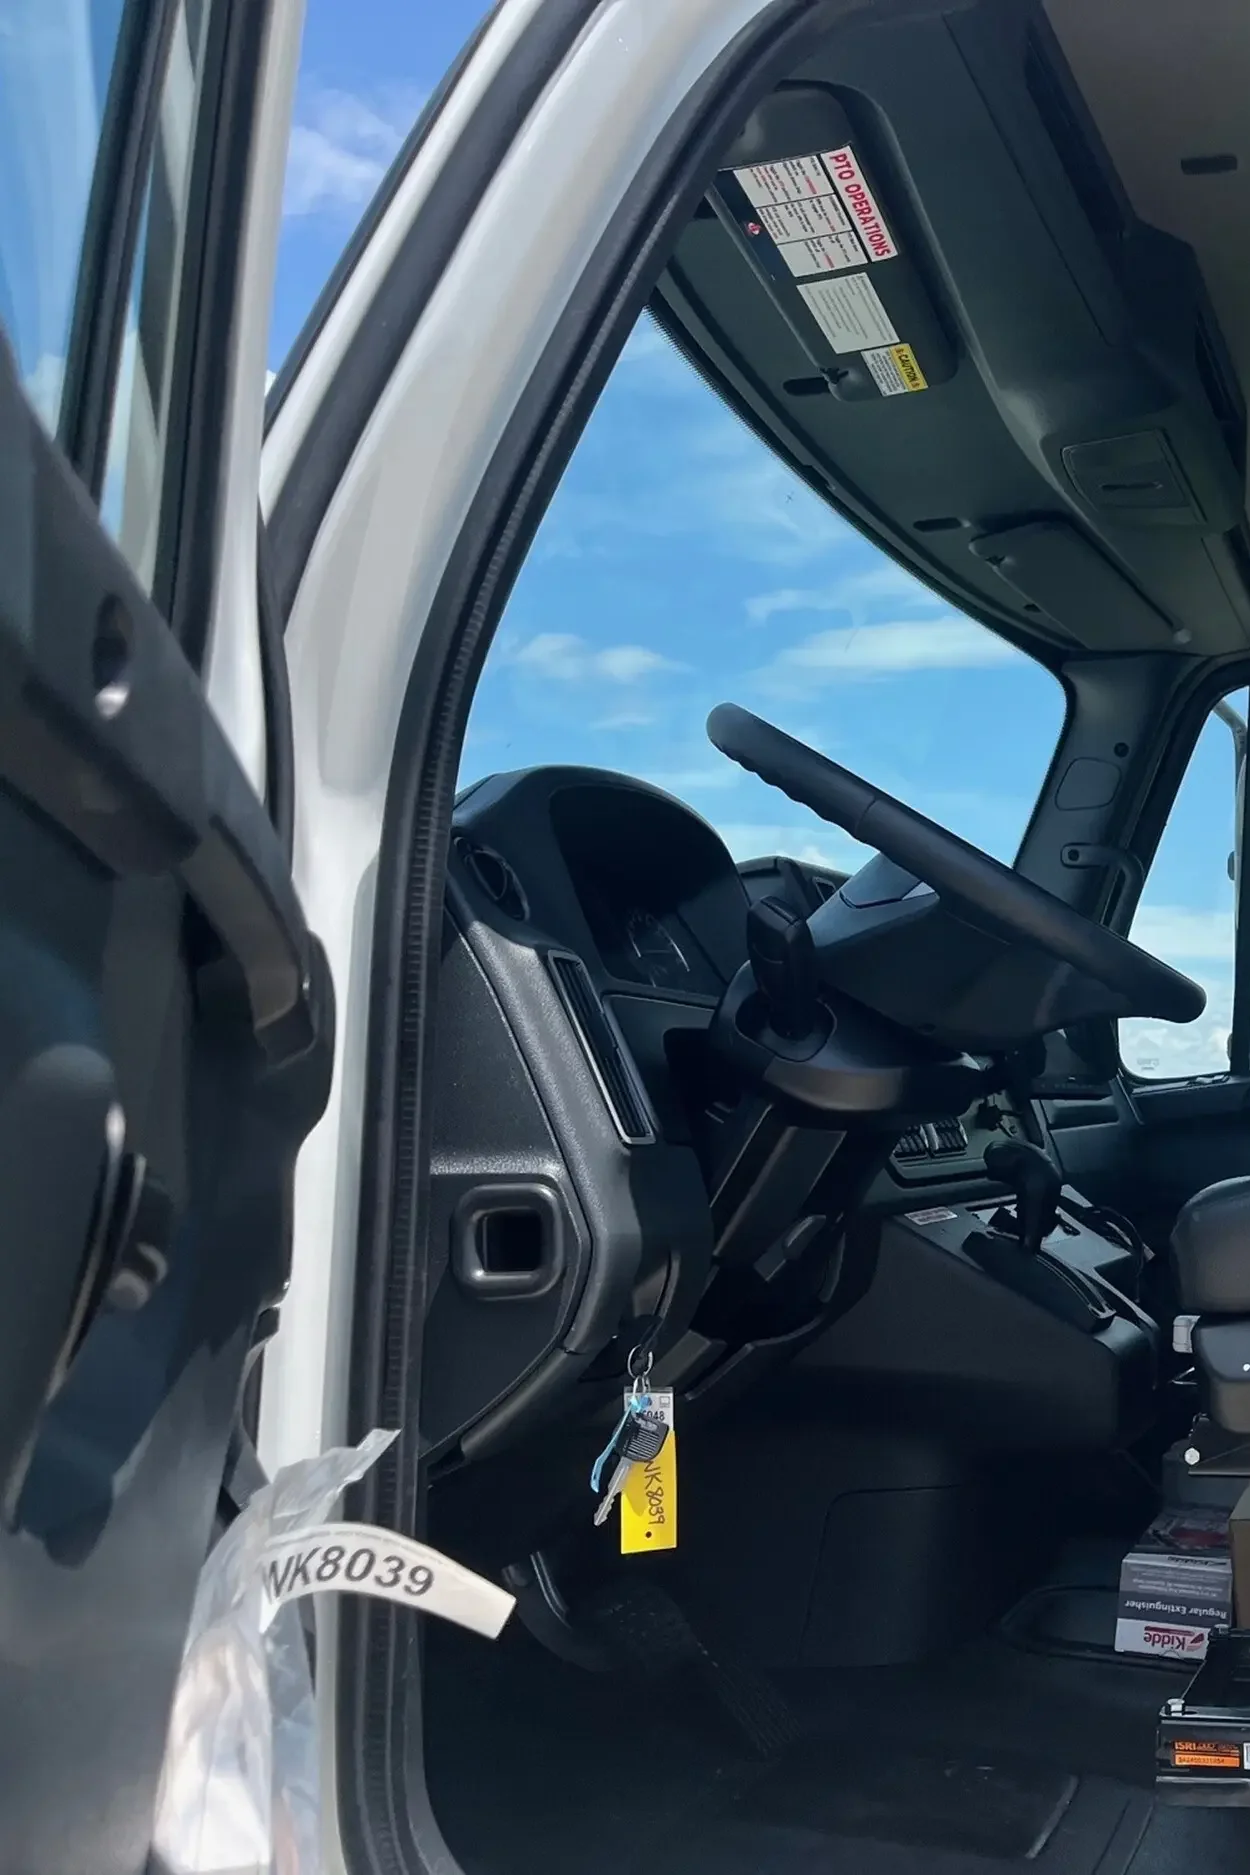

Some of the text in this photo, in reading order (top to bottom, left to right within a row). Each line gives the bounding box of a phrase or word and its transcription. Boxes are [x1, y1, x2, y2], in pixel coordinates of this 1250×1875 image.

[832, 153, 891, 258] PTO OPERATIONS
[897, 353, 915, 383] CAUTION
[262, 1545, 435, 1604] WK8039
[1125, 1599, 1228, 1620] Regular Extinguisher
[1143, 1631, 1186, 1651] Kidde
